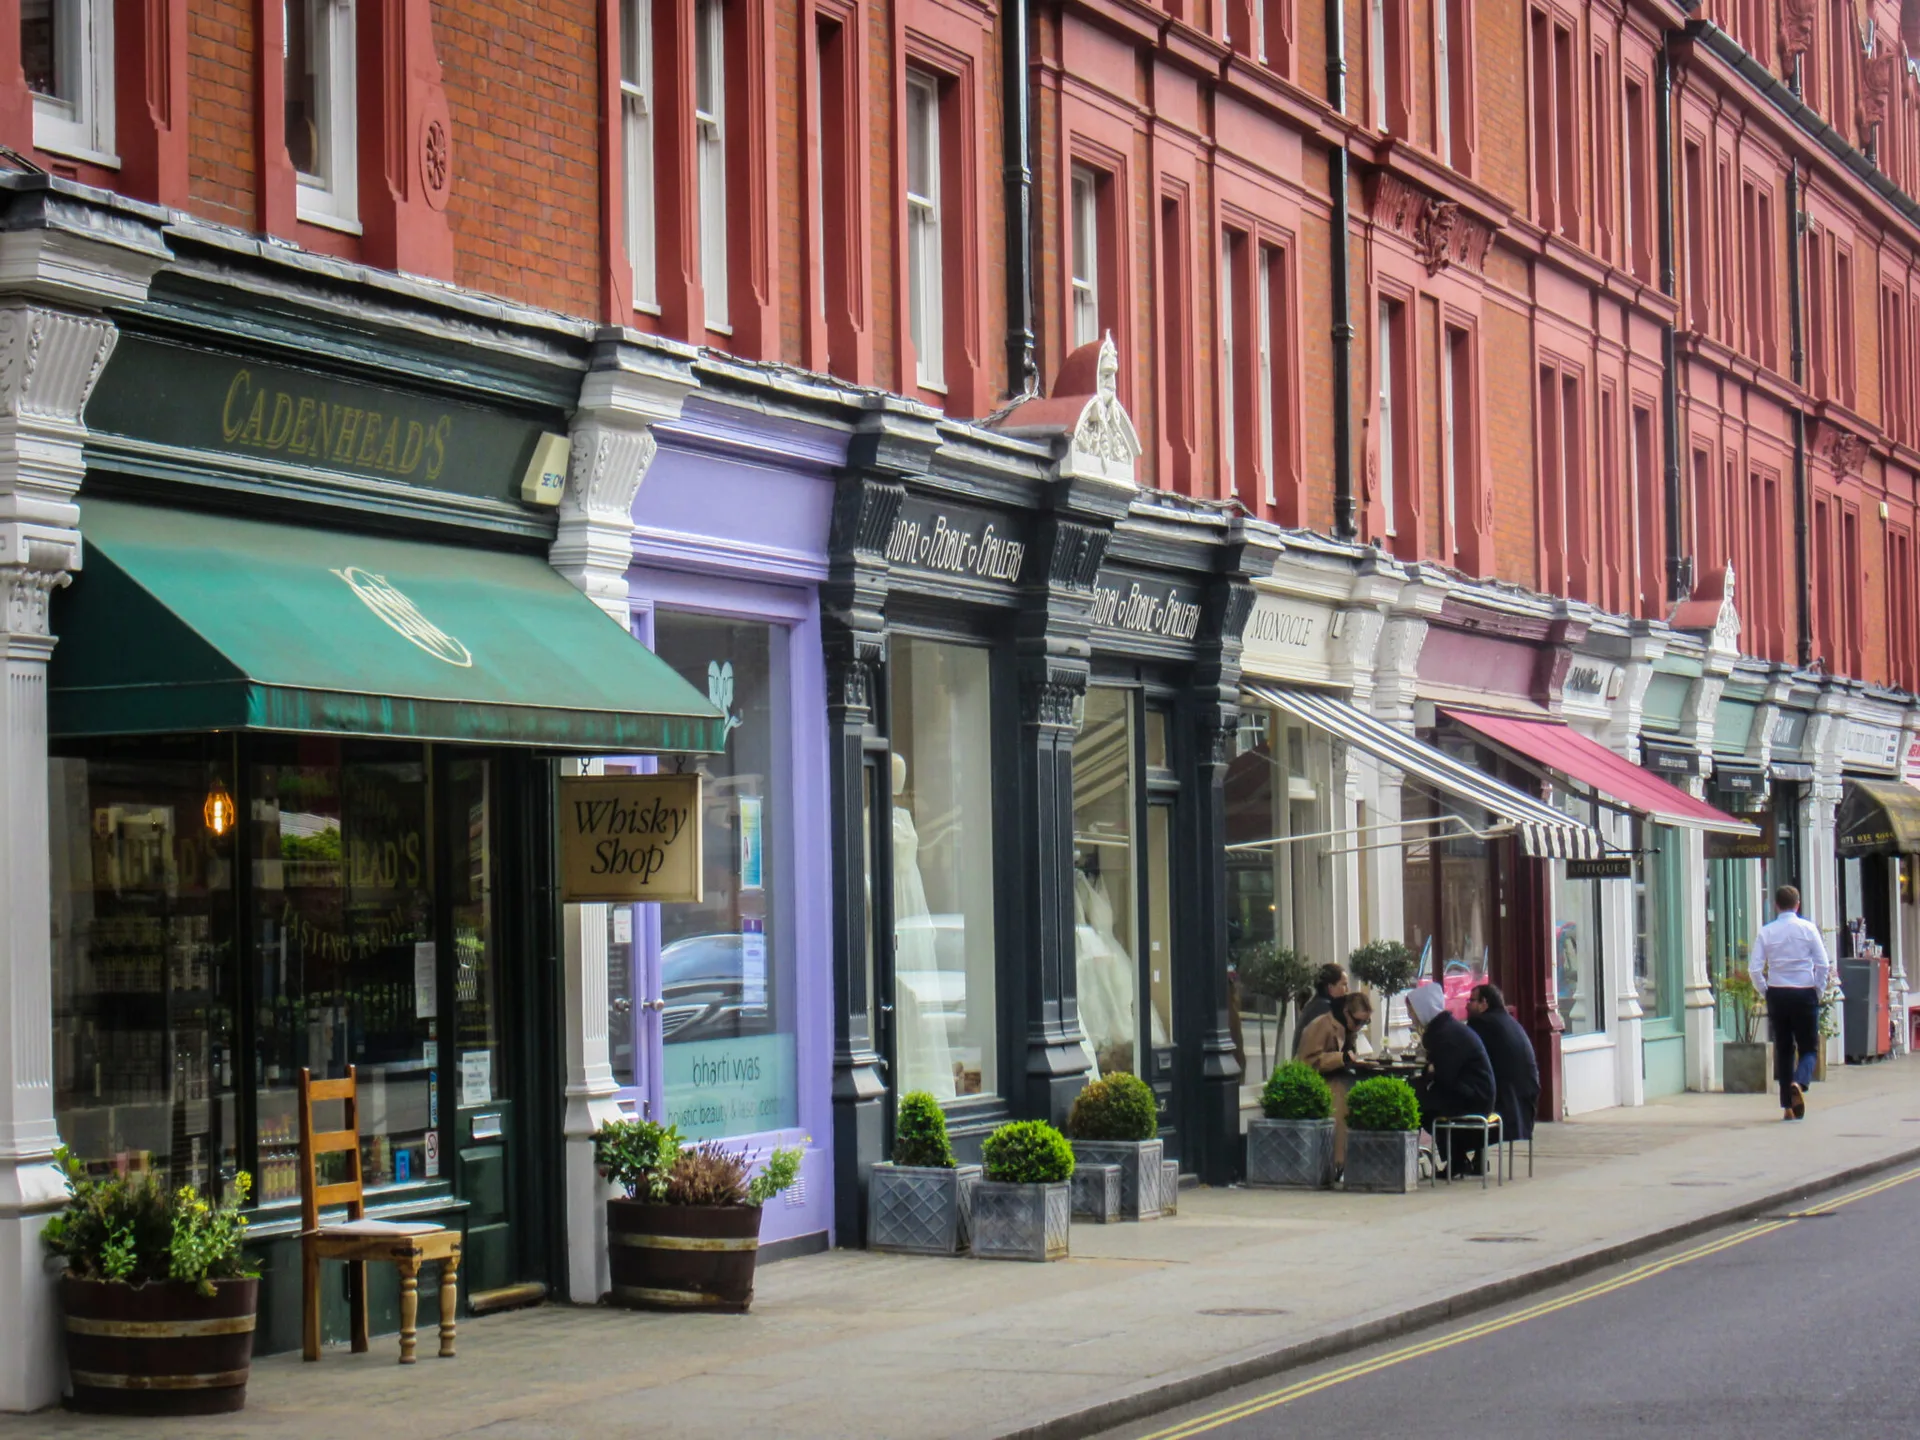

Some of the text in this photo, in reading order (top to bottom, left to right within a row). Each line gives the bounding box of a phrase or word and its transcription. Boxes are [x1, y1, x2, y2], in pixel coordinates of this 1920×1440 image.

[222, 368, 452, 480] CADENHEAD'S
[976, 523, 1026, 583] GALLERY
[1161, 589, 1202, 640] GALLERY
[1250, 609, 1314, 647] MONOCLE
[574, 796, 687, 845] Whisky
[590, 837, 664, 885] Shop
[1570, 863, 1629, 874] ANTIQUES
[692, 1051, 761, 1090] bharti vyas
